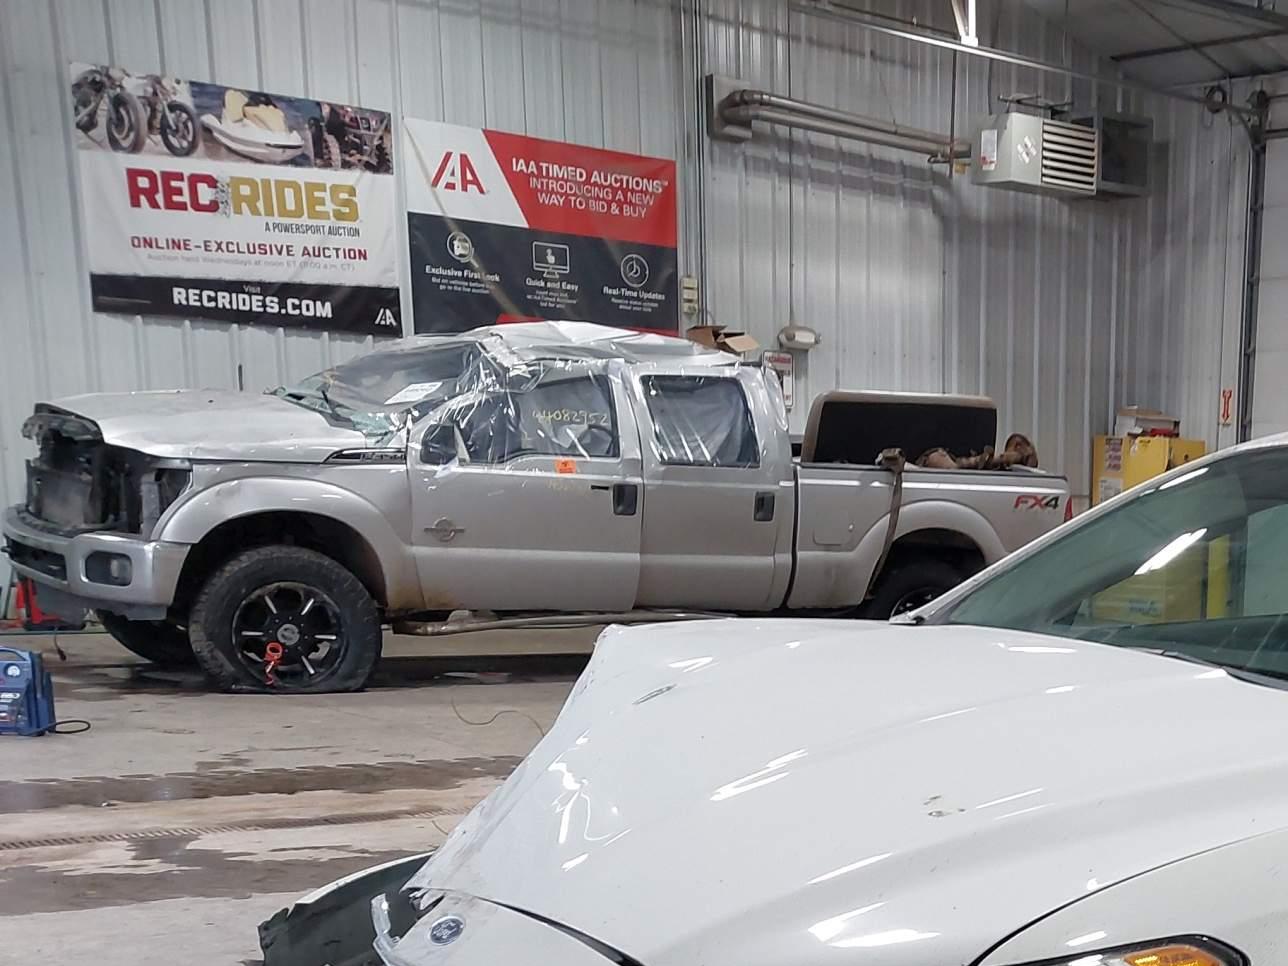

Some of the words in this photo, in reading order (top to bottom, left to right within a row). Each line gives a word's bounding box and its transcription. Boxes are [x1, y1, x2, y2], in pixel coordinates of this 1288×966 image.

[512, 157, 538, 176] IAA
[539, 162, 587, 182] TIMED
[126, 168, 220, 213] REC
[230, 176, 360, 222] RIDES
[529, 176, 613, 200] INTRODUCING
[615, 190, 625, 201] A
[627, 192, 655, 206] NEW
[537, 192, 566, 207] WAY
[568, 196, 586, 210] TO
[588, 200, 608, 213] BID
[610, 201, 621, 215] &
[623, 203, 648, 219] BUY
[264, 221, 271, 232] A
[272, 222, 326, 235] POWERSPORT
[327, 225, 360, 237] AUCTION
[131, 236, 295, 257] ONLINE-EXCLUSIVE
[301, 245, 369, 260] AUCTION
[425, 265, 463, 277] Exclusive
[243, 285, 261, 293] Visit
[526, 277, 545, 287] Quick
[562, 281, 579, 292] Easy
[603, 285, 638, 298] Real-Time
[639, 290, 666, 300] Updates
[172, 287, 333, 318] RECRIDES.COM
[1014, 495, 1060, 510] FX4
